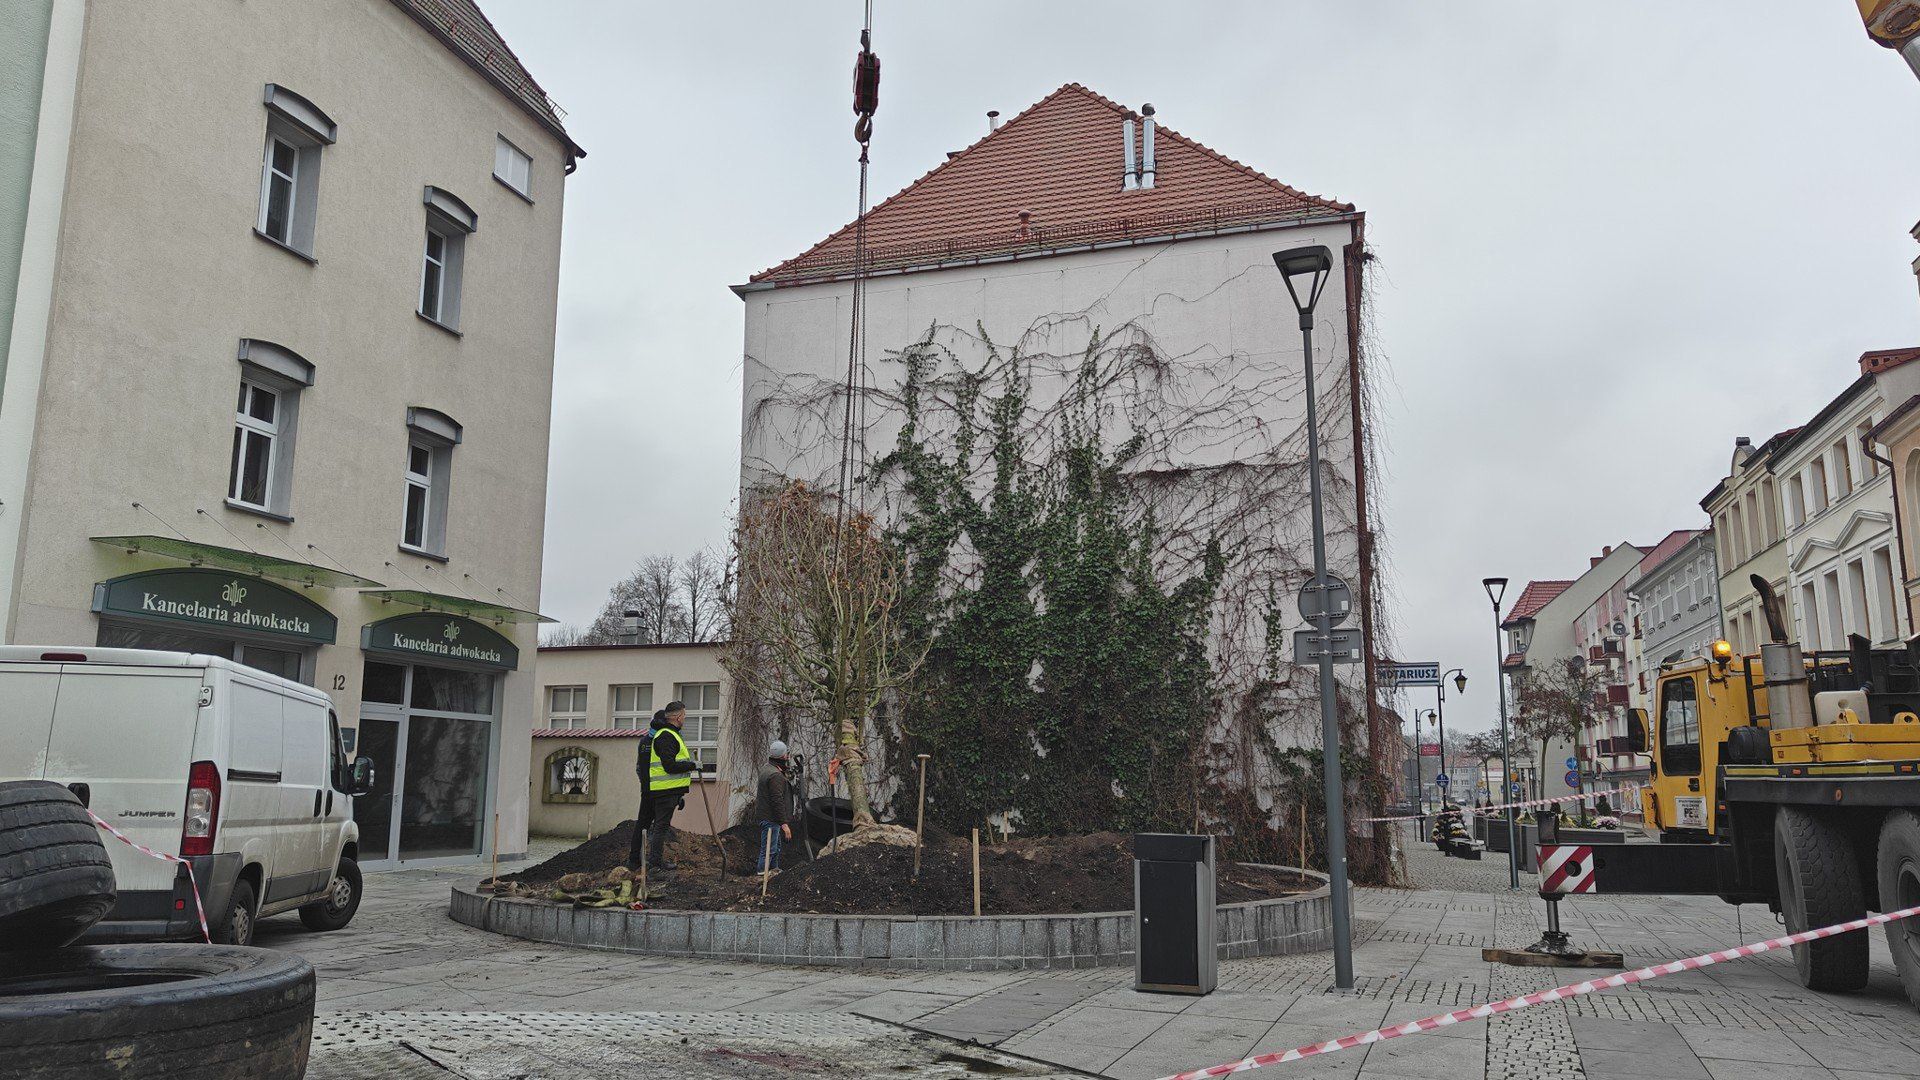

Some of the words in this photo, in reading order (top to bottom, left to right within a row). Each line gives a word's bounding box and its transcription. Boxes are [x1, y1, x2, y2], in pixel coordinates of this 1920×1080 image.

[142, 592, 228, 622] Kancelaria
[233, 609, 310, 634] adwokacka
[393, 633, 448, 655] Kancelaria
[450, 643, 501, 663] adwokacka
[332, 674, 346, 691] 12
[118, 809, 176, 818] JUMPER
